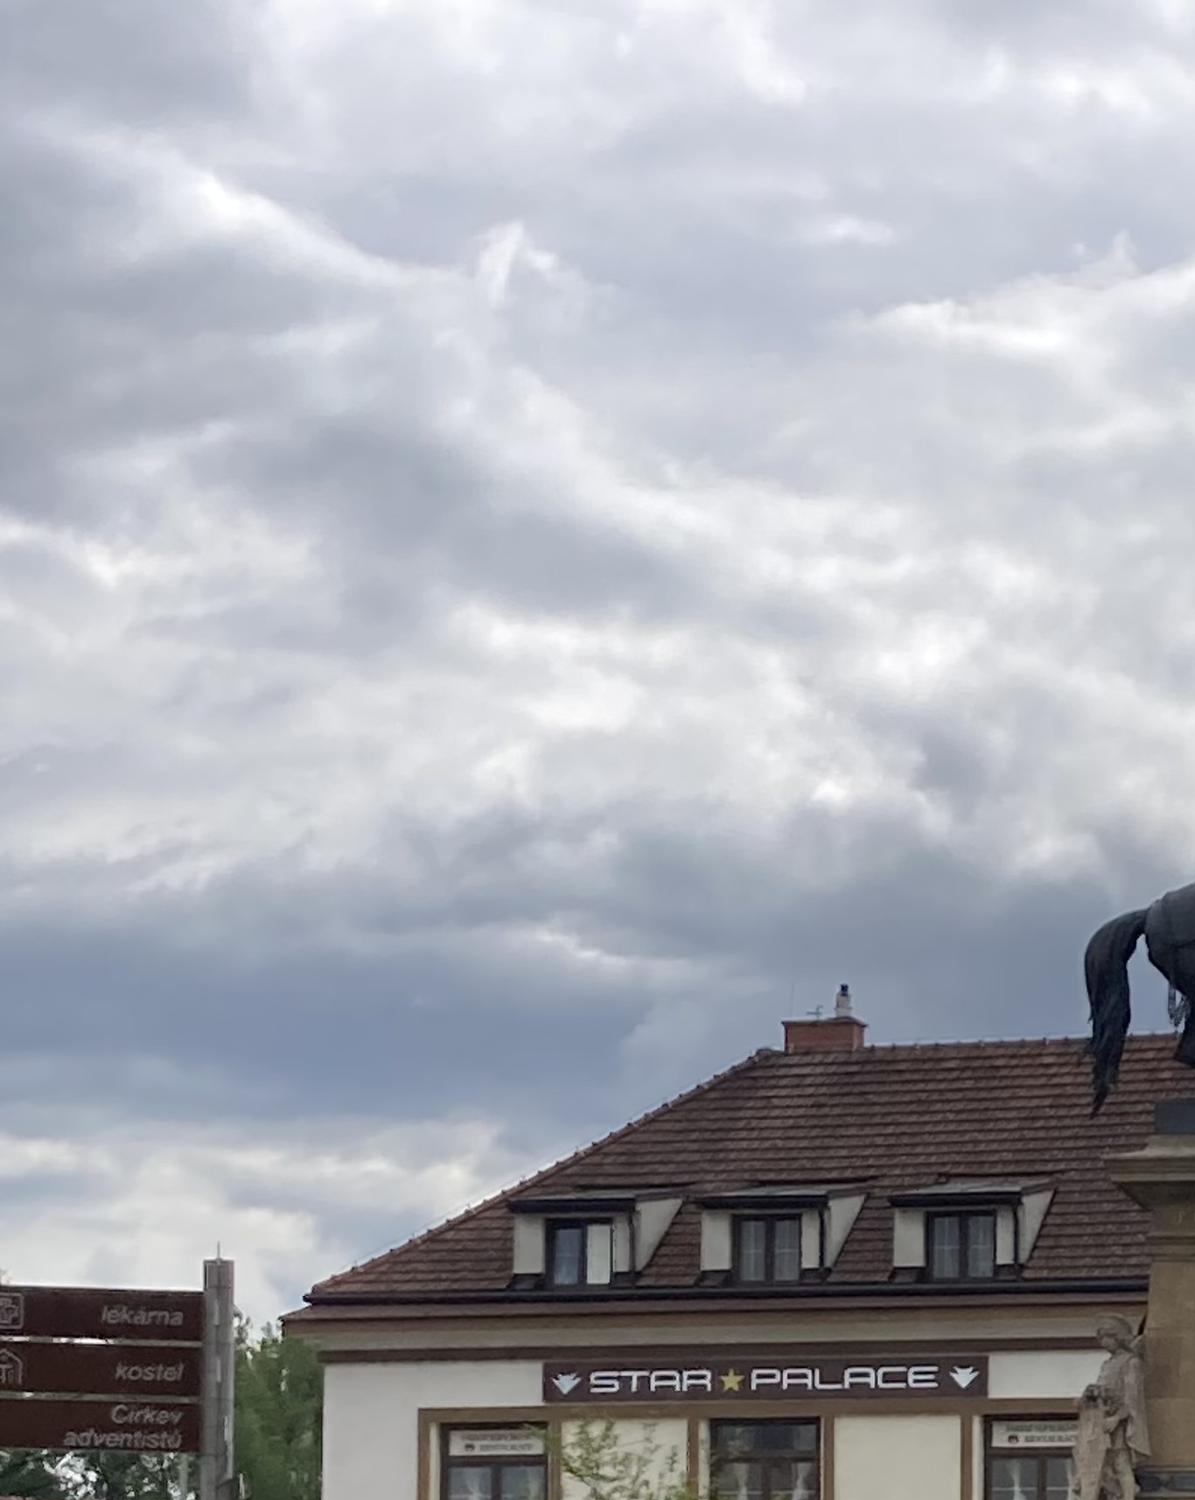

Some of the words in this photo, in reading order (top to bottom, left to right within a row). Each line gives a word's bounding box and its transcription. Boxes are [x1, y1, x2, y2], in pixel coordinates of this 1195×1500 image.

[115, 1361, 184, 1382] kostel
[588, 1368, 712, 1394] STAR
[750, 1364, 940, 1391] PALACE
